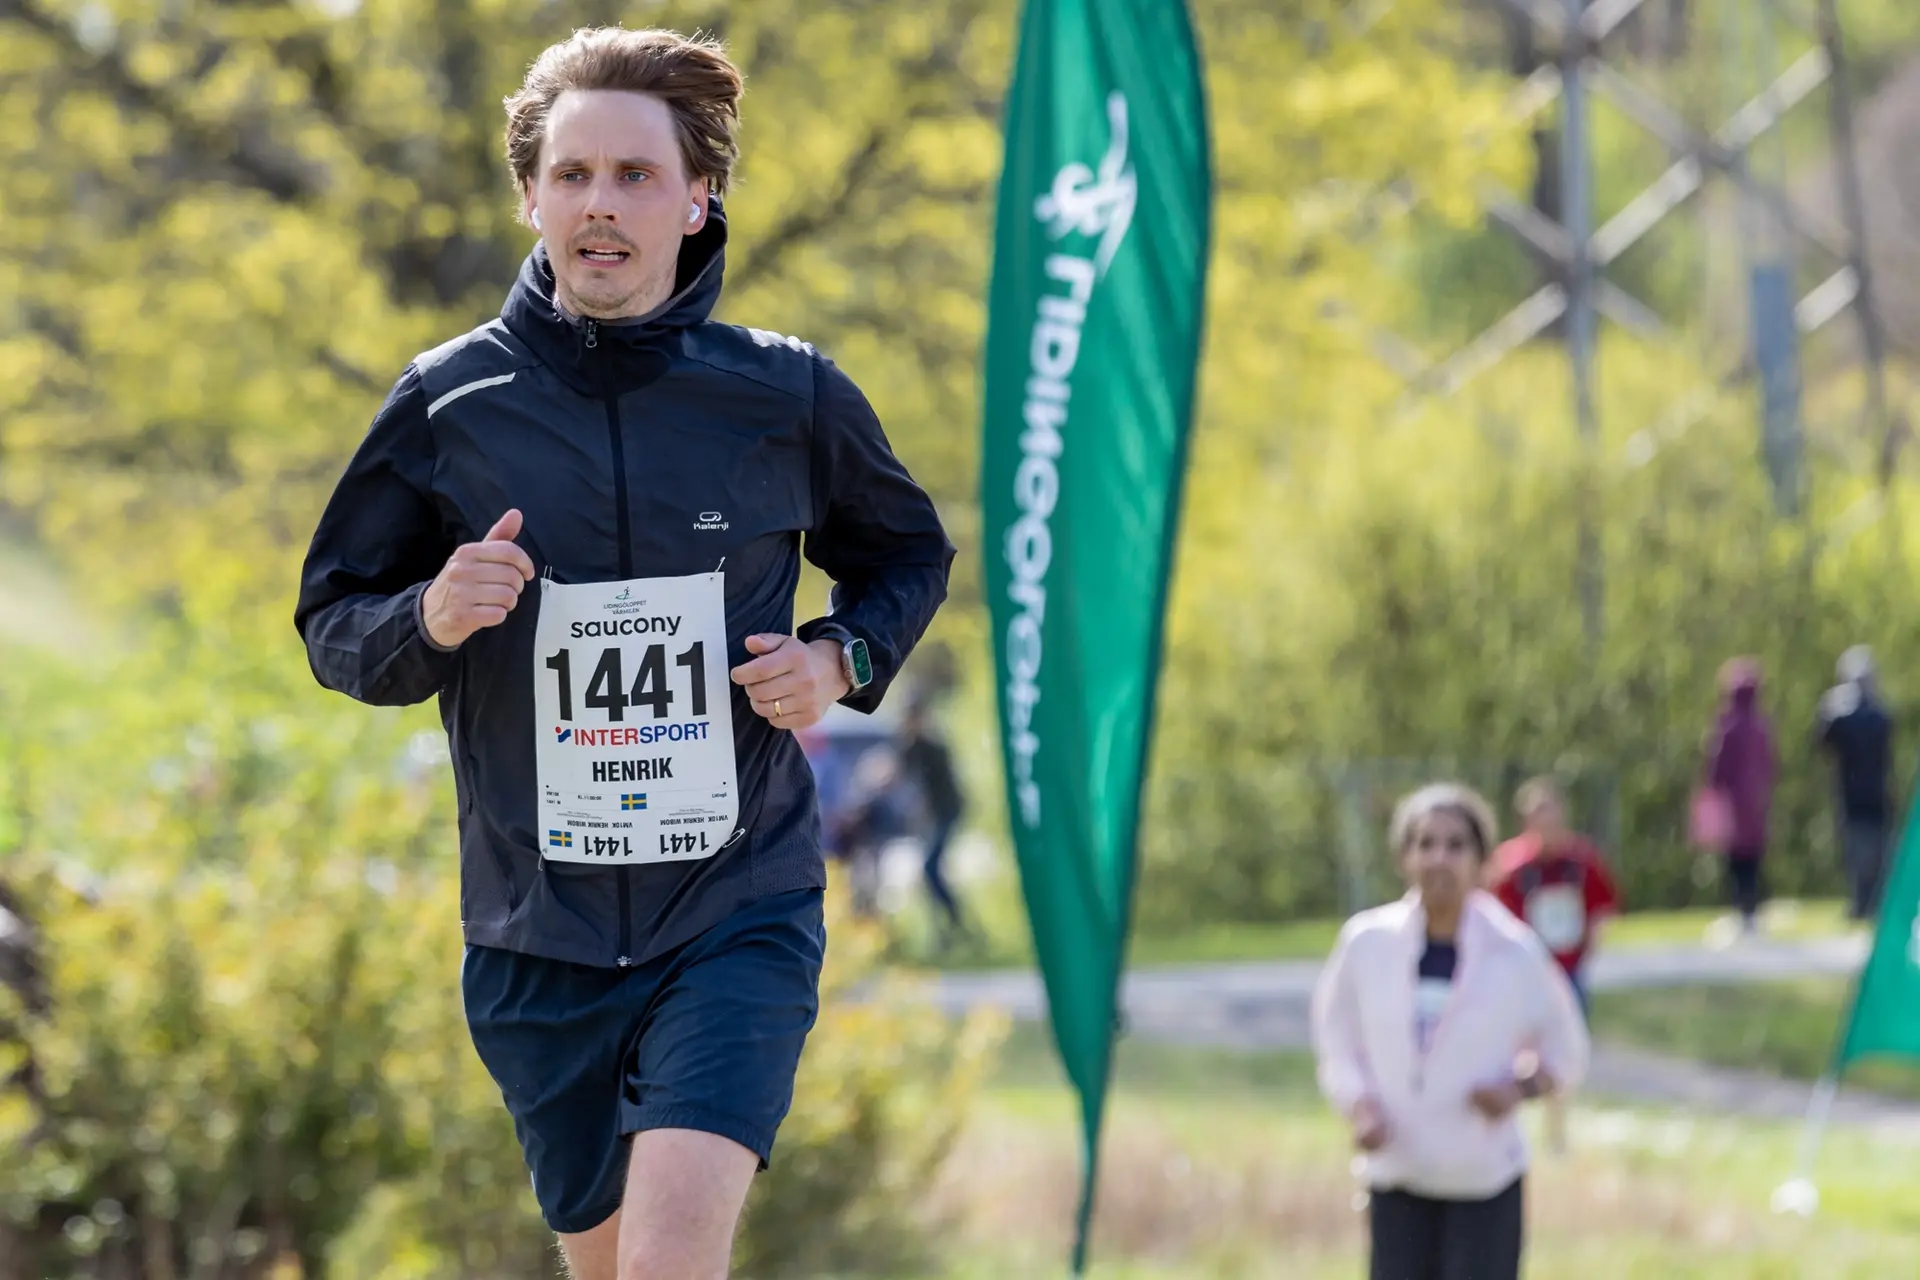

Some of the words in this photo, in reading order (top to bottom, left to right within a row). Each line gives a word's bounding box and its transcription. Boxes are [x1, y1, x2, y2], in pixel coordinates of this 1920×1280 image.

[693, 521, 729, 531] Kalenji
[603, 599, 647, 610] LIDINGÖLOPPET
[570, 615, 682, 638] saucony
[546, 640, 707, 722] 1441
[574, 722, 710, 746] INTERSPORT
[592, 757, 673, 782] HENRIK
[660, 818, 681, 826] WIBOM
[683, 816, 705, 824] HENRIK
[584, 835, 633, 857] 1441
[660, 831, 709, 855] 1441
